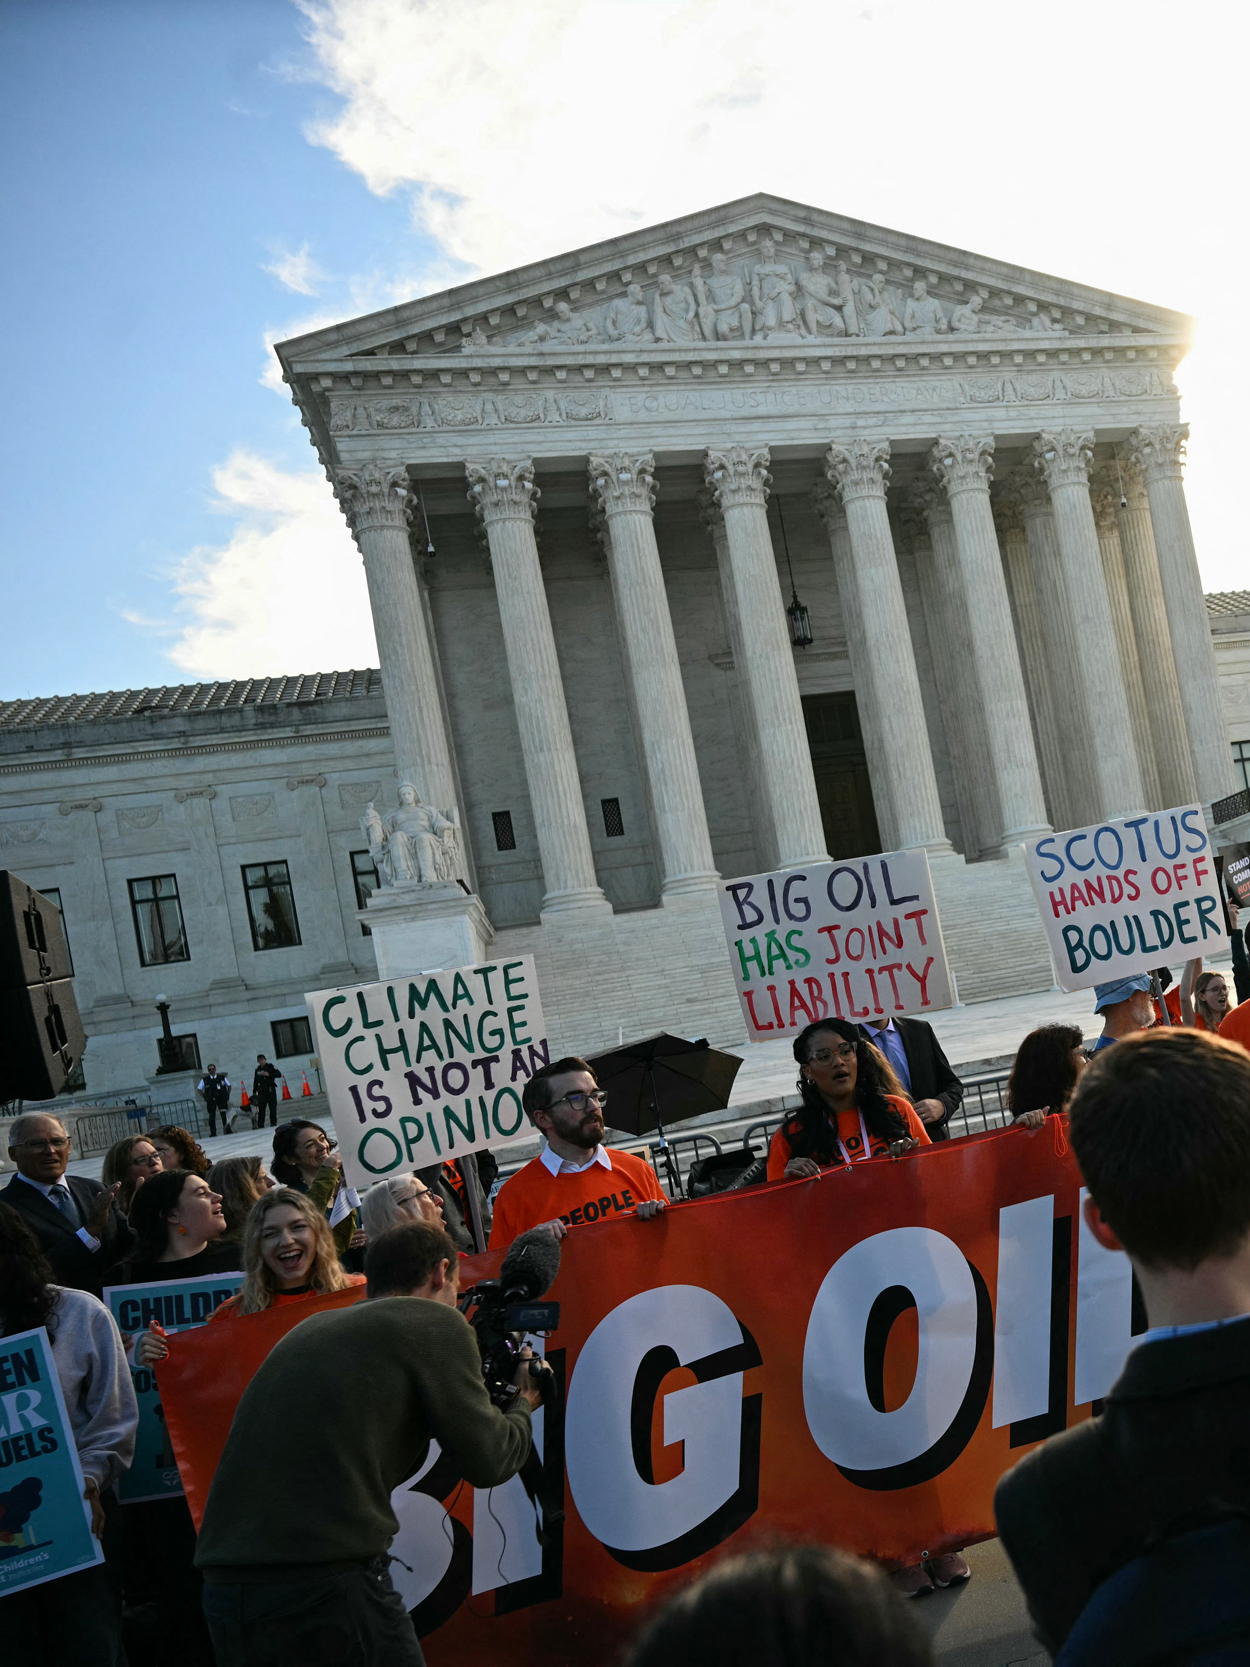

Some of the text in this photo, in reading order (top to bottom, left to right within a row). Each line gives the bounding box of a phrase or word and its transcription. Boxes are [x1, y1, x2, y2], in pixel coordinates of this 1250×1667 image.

[627, 394, 711, 413] EQUAL
[713, 390, 808, 410] JUSTICE
[818, 387, 890, 406] UNDER
[1035, 809, 1208, 883] SCOTUS
[1228, 856, 1250, 874] STAND
[726, 860, 919, 930] BIG OIL
[1049, 855, 1209, 918] HANDS OFF
[1237, 881, 1250, 894] NOT
[734, 908, 929, 982] HAS JOINT
[1061, 894, 1222, 974] BOULDER
[322, 960, 529, 1038] CLIMATE
[743, 956, 934, 1031] LIABILITY
[345, 1003, 532, 1076] CHANGE
[349, 1038, 550, 1124] IS NOT AN
[358, 1083, 536, 1174] OPINIO
[119, 1288, 241, 1331] CHILD
[0, 1426, 58, 1468] UELS
